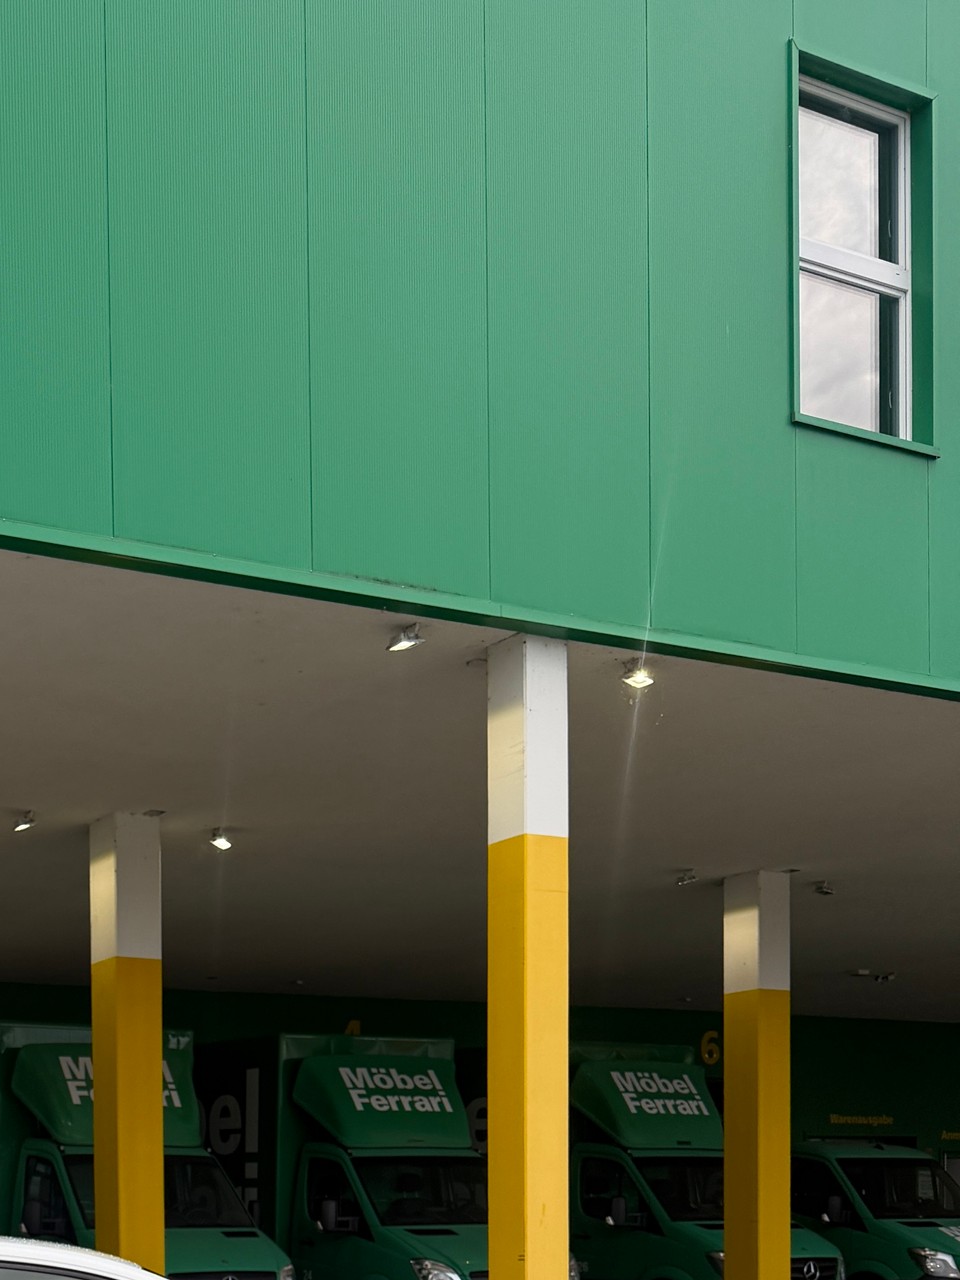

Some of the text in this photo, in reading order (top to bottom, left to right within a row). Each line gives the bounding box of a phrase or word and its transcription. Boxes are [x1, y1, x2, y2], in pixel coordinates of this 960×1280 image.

[701, 1030, 720, 1066] 6
[338, 1066, 444, 1091] Möbel
[610, 1071, 698, 1095] Möbel
[348, 1088, 454, 1113] Ferrari
[622, 1092, 710, 1117] Ferrari
